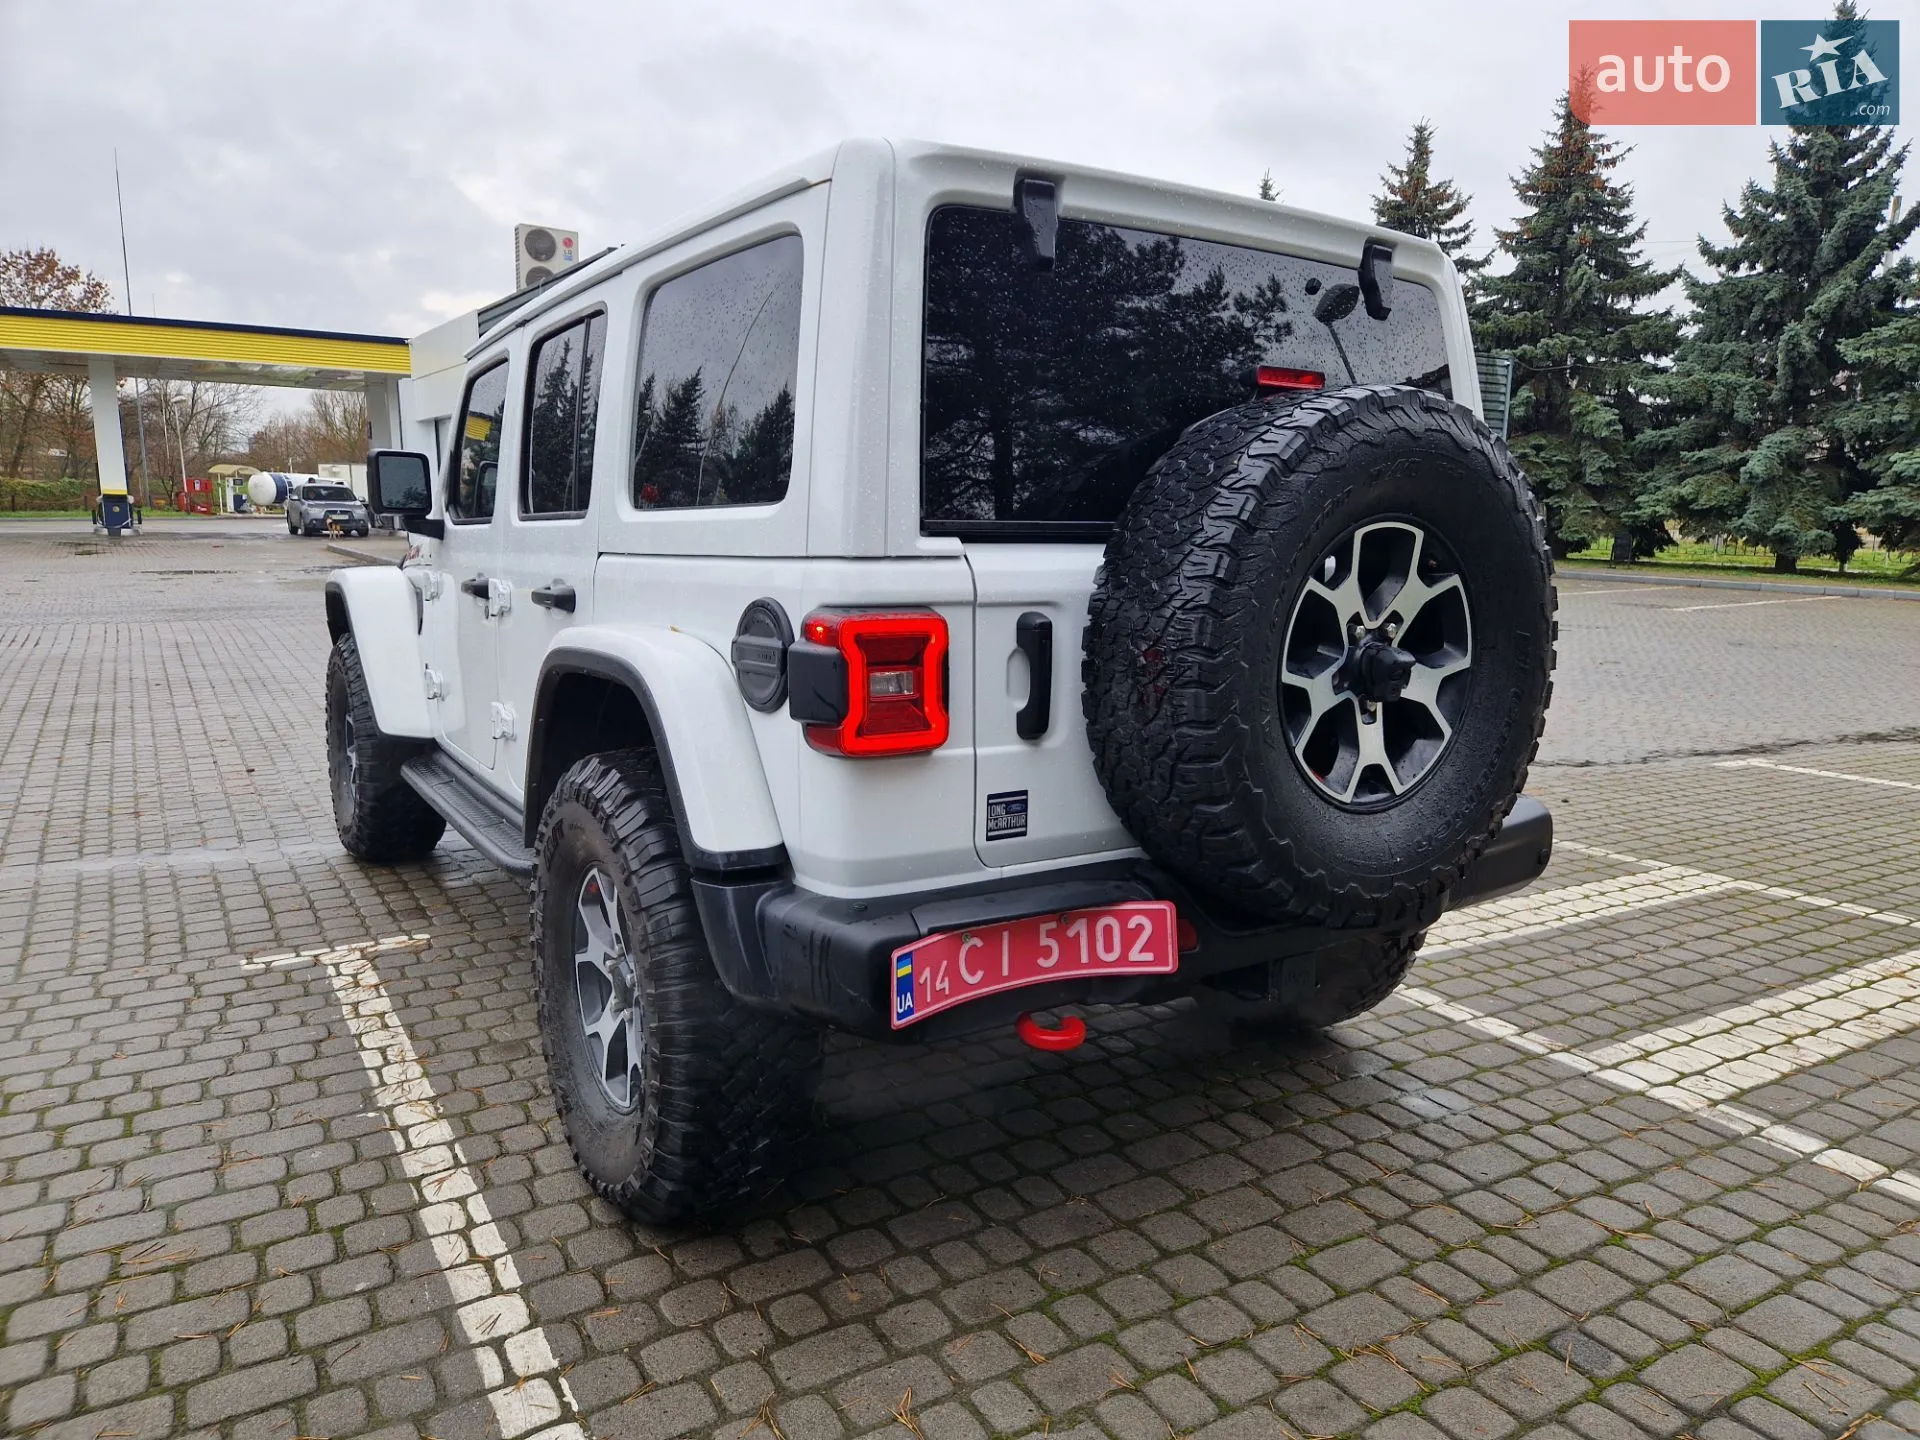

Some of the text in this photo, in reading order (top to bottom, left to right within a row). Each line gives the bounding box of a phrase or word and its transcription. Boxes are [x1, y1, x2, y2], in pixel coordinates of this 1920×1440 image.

[988, 803, 1006, 817] LONG
[918, 960, 949, 1002] 14
[1037, 915, 1154, 968] 5102
[896, 994, 914, 1014] UA
